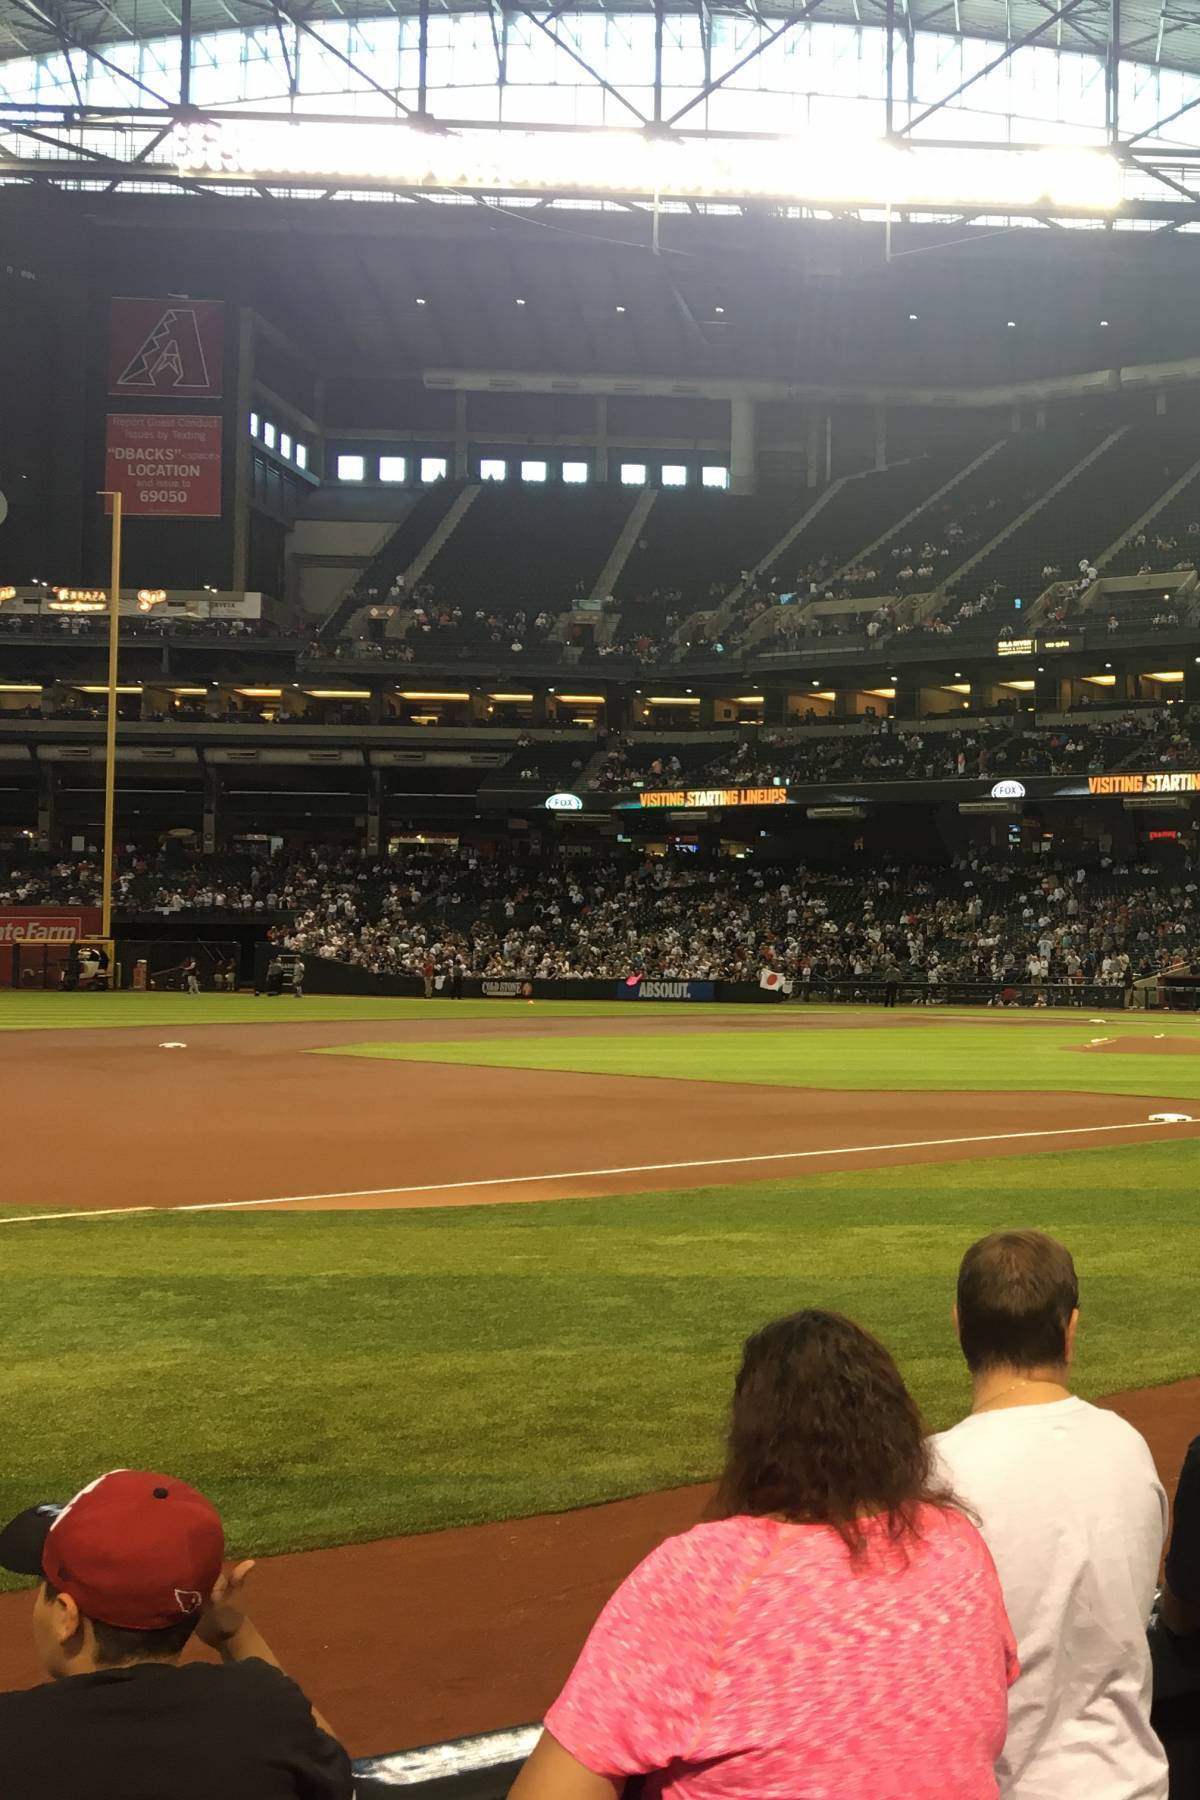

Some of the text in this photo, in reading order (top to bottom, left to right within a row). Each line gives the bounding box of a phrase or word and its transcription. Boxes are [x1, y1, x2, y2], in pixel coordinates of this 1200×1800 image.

[127, 464, 200, 477] LOCATION
[139, 490, 188, 503] 69050
[999, 786, 1017, 795] FOX
[1088, 775, 1143, 794] VISITING
[553, 799, 573, 807] FOX
[639, 788, 787, 808] VISITING STARTING LINEUPS
